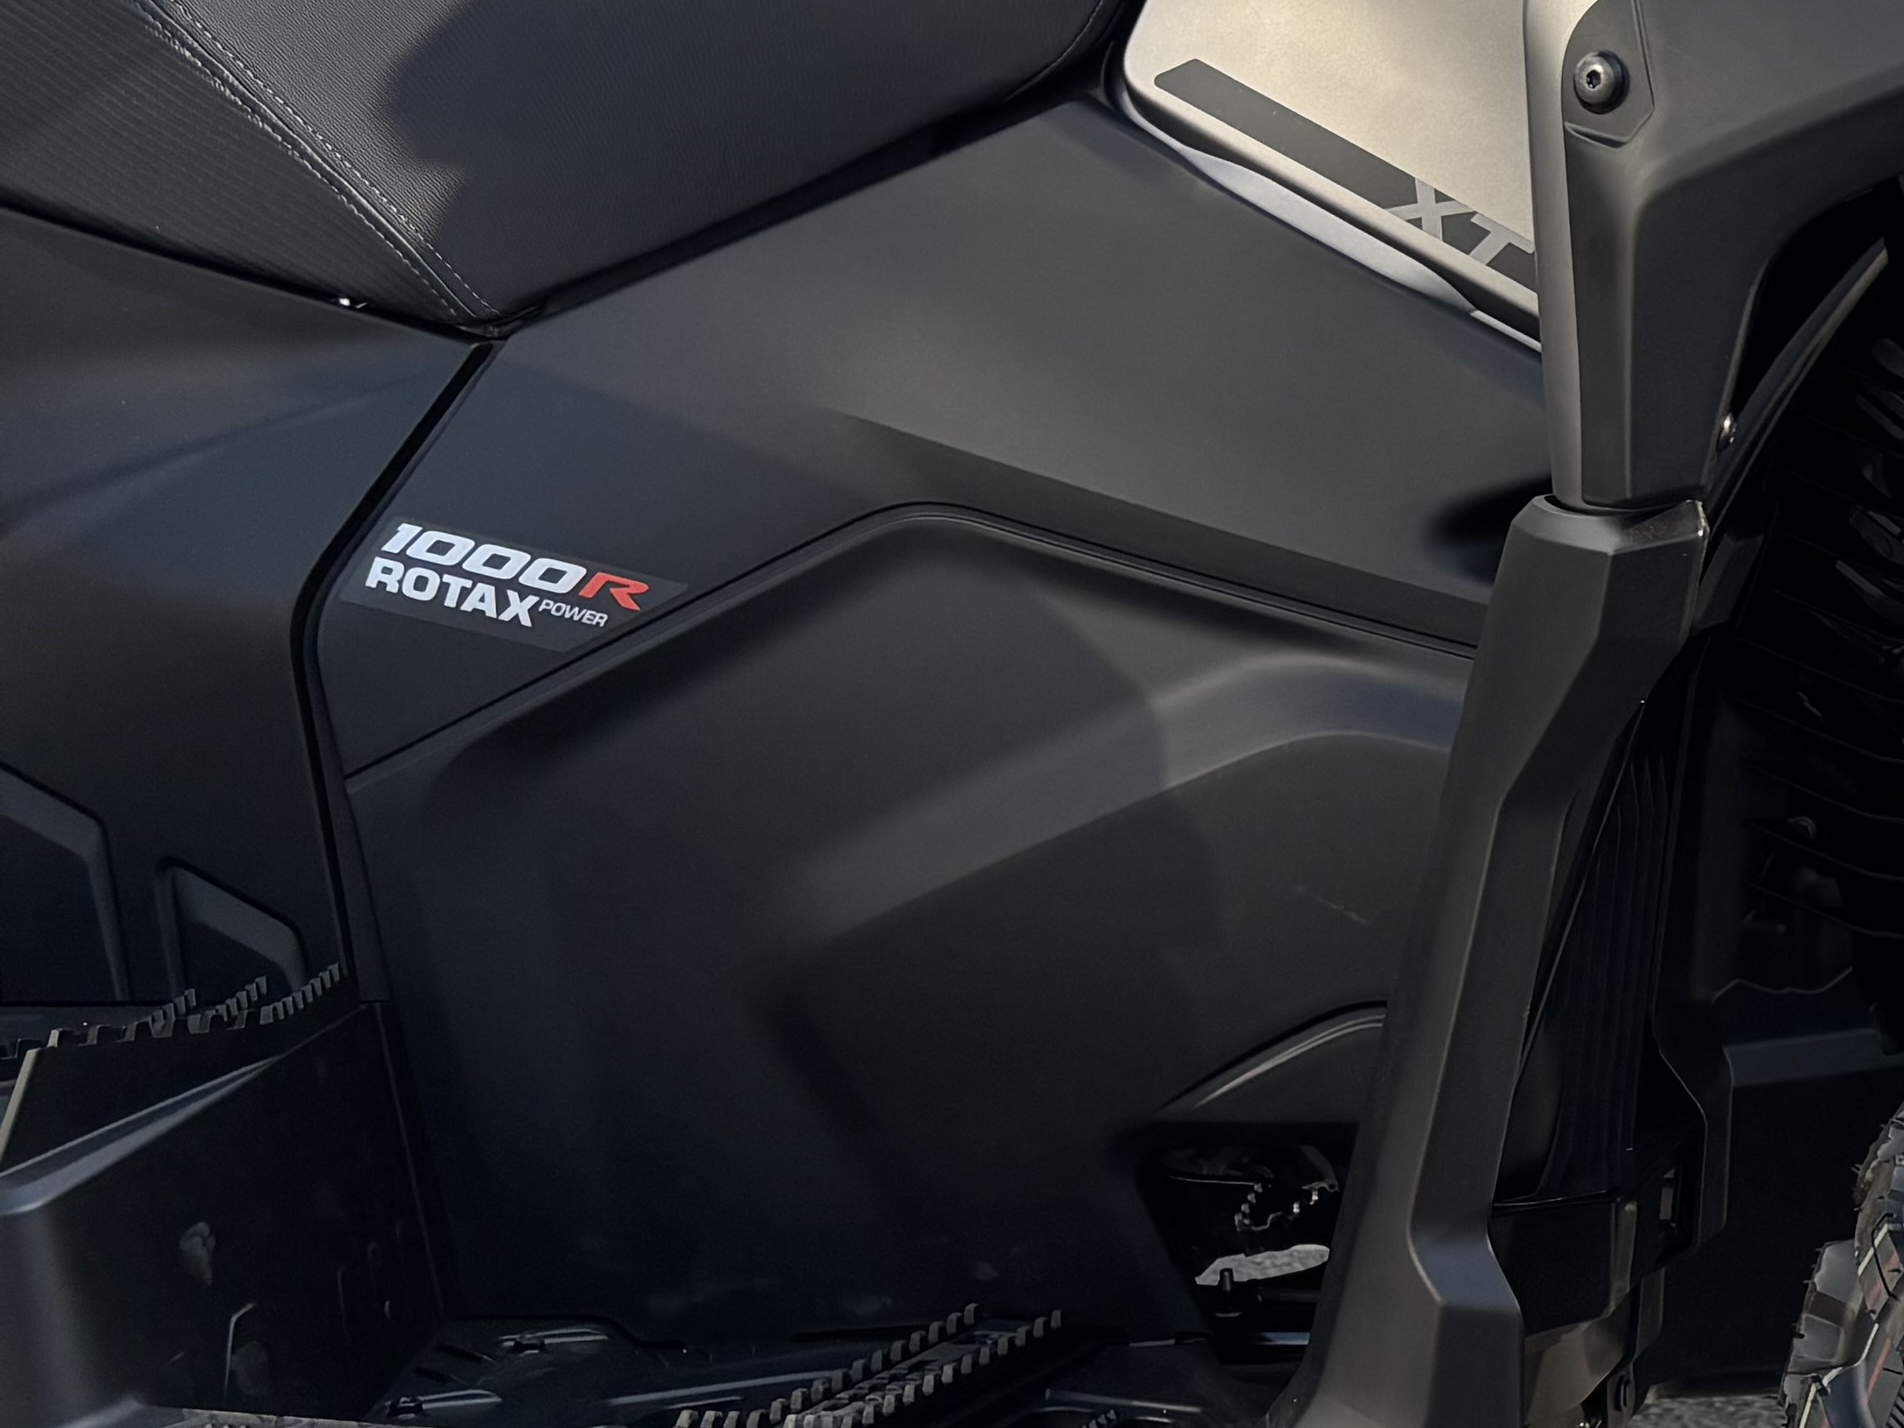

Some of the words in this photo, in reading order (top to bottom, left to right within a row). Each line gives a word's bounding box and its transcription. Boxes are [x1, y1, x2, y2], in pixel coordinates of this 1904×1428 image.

[1385, 178, 1537, 266] XT
[365, 556, 542, 629] ROTAX
[538, 598, 609, 629] POWER
[380, 522, 652, 612] 1000R
